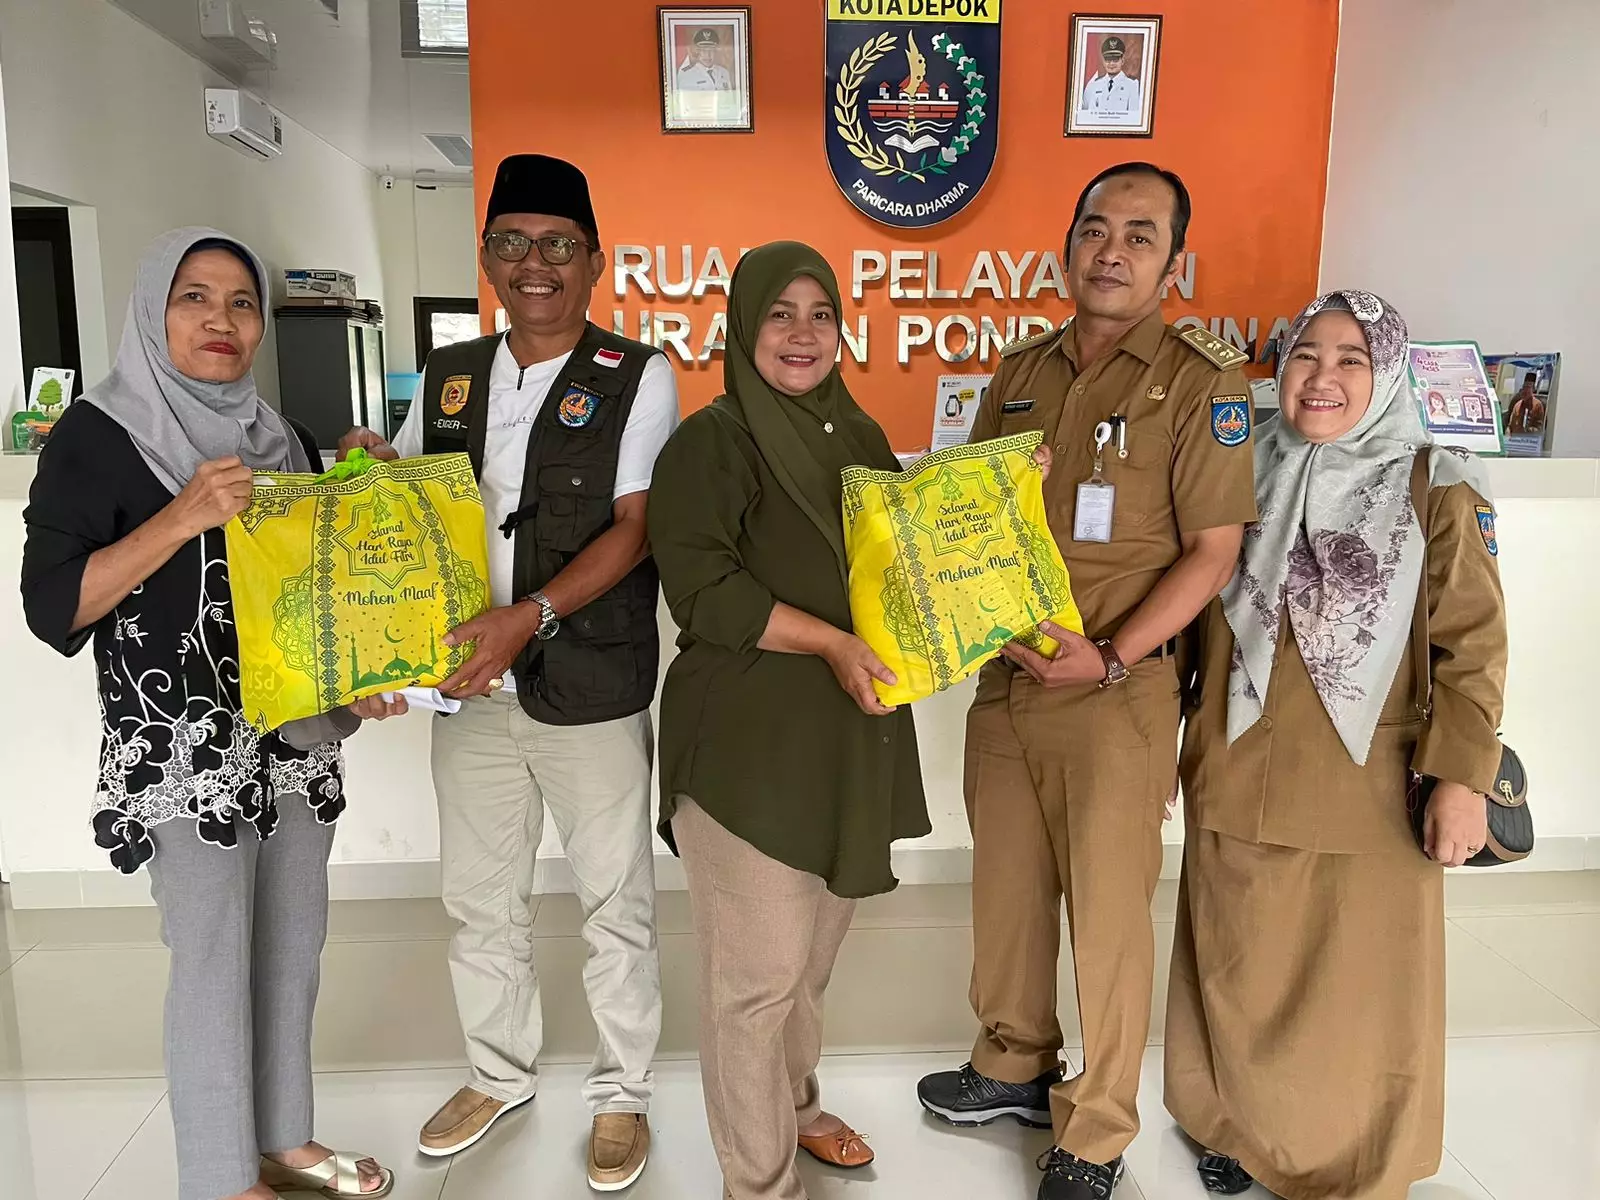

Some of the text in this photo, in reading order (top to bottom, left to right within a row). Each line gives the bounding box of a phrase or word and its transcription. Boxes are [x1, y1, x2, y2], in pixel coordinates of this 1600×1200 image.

[839, 0, 989, 17] KOTA DEPOK
[852, 178, 970, 217] PARICARA DHARMA
[613, 244, 1196, 300] RUA PELAYAN
[935, 511, 992, 531] Hari Raya
[355, 536, 414, 553] Hari Raya
[942, 527, 968, 543] Idul
[360, 552, 388, 565] Idul
[935, 551, 1021, 585] Mohon Maaf
[343, 581, 437, 606] Mohon Maaf
